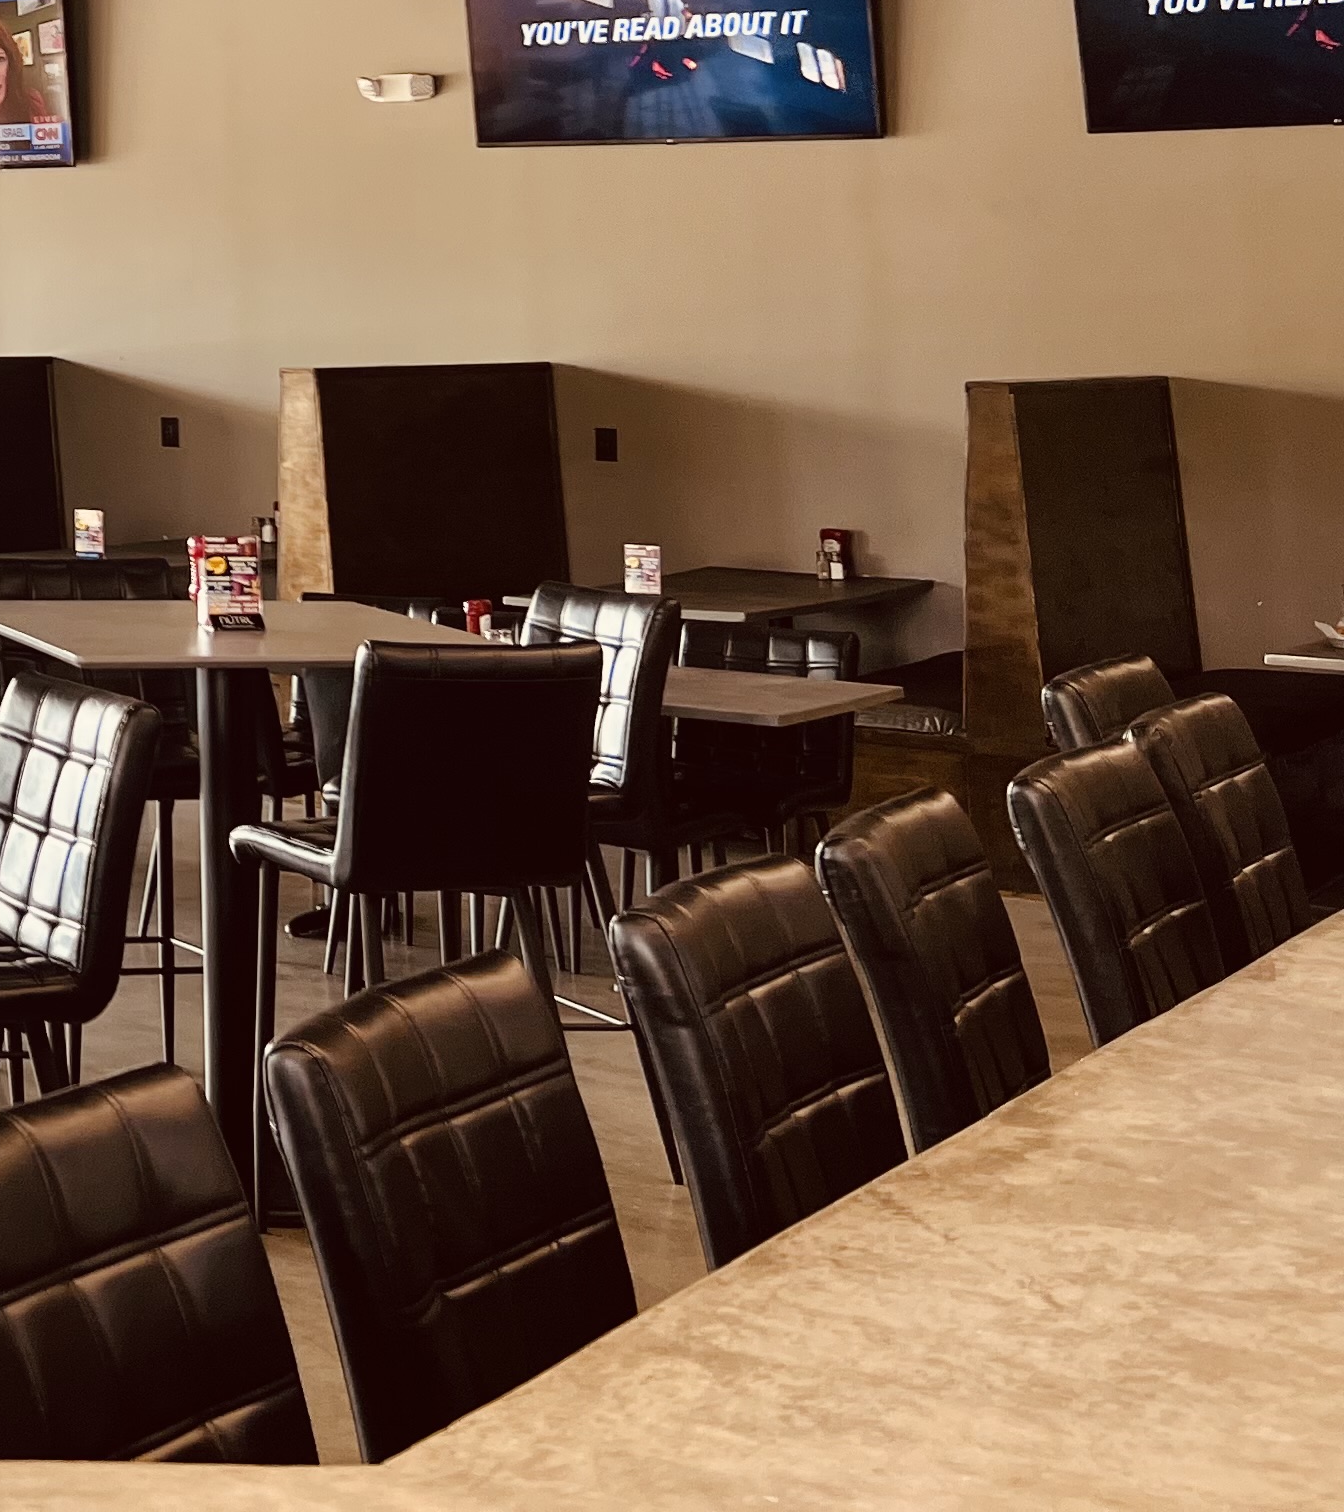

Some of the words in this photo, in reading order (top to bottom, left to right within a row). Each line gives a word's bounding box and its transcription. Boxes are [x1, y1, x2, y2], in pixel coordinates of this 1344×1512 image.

[520, 19, 609, 46] YOU'VE
[612, 16, 681, 43] READ
[683, 11, 777, 38] ABOUT
[780, 9, 809, 35] IT
[35, 127, 59, 140] CNN
